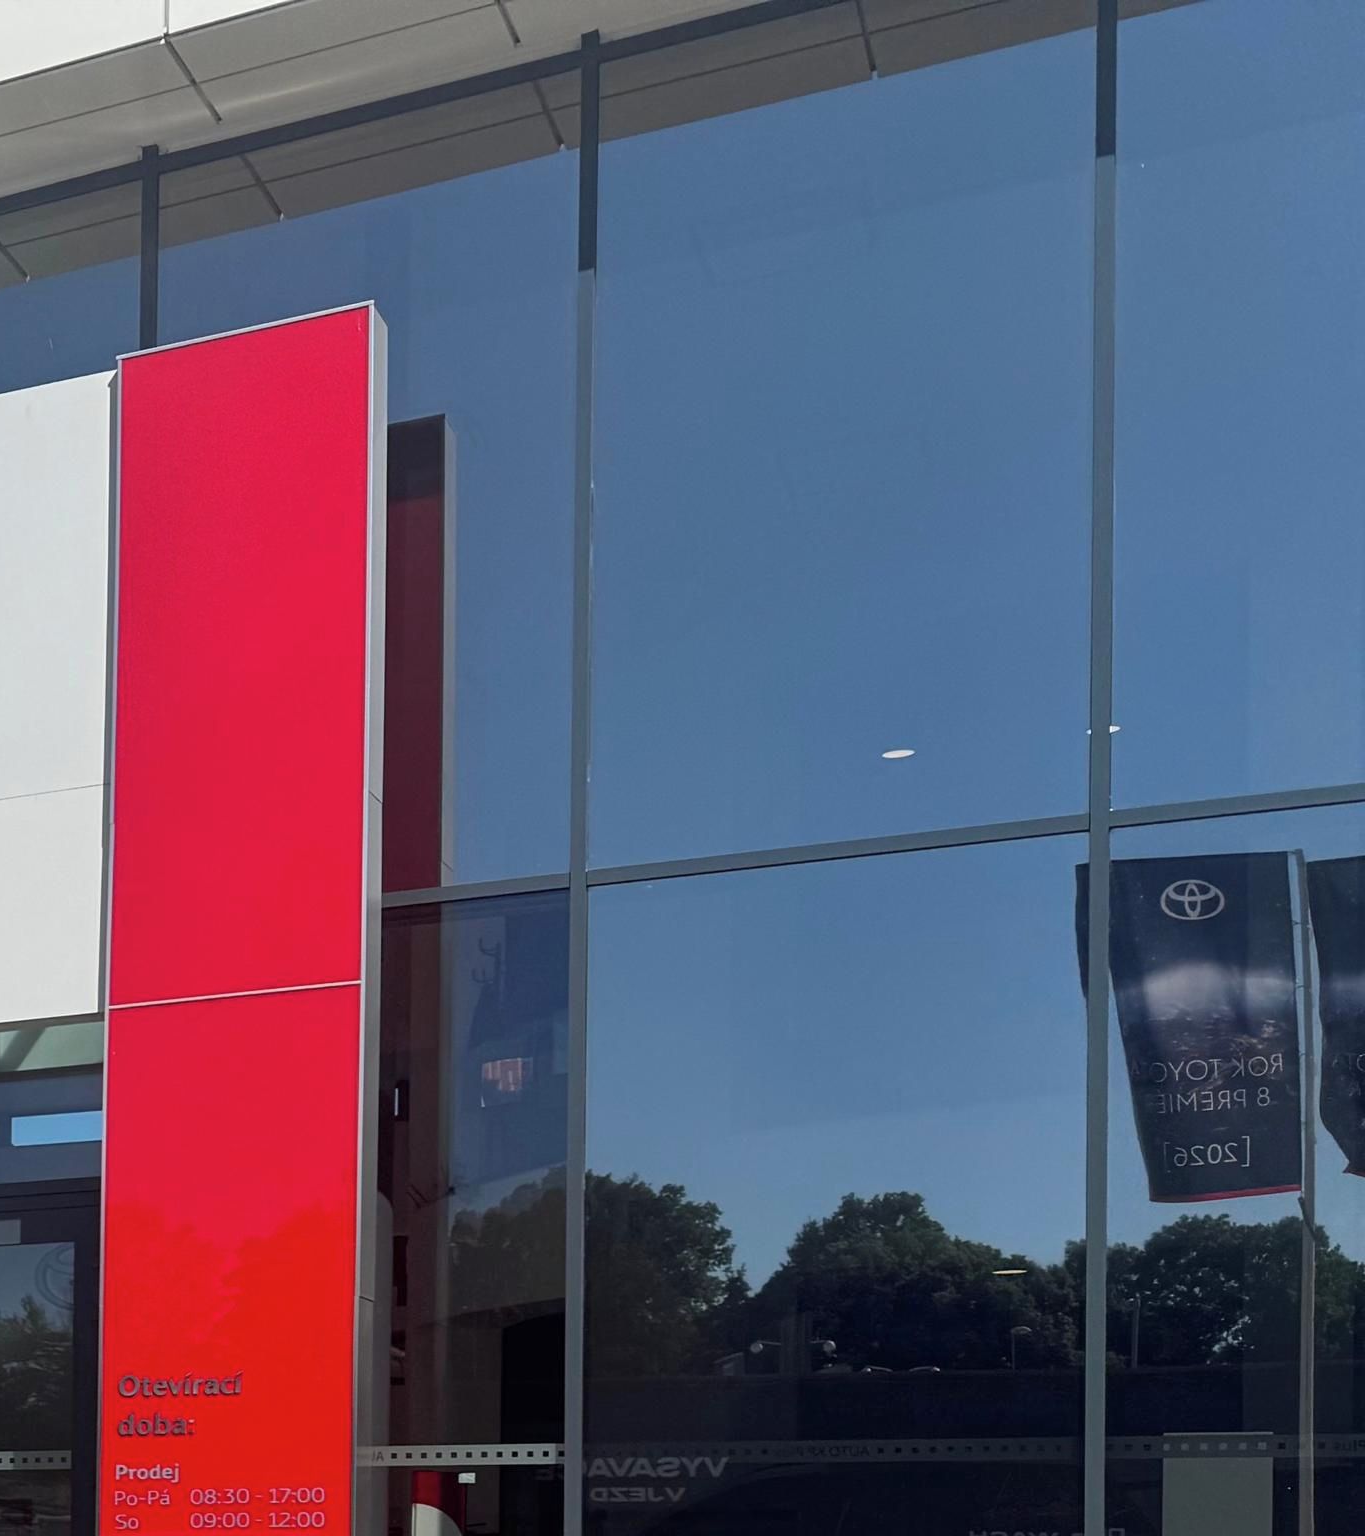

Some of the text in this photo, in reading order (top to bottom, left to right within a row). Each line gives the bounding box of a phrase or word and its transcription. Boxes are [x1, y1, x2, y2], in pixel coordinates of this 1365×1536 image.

[118, 1372, 243, 1397] Otevírací
[115, 1464, 180, 1483] Prodej
[114, 1490, 171, 1505] Po-Pá
[190, 1488, 250, 1504] 08:30
[269, 1487, 325, 1504] 17:00
[115, 1514, 139, 1530] So
[190, 1512, 250, 1528] 09:00
[269, 1511, 325, 1528] 12:00
